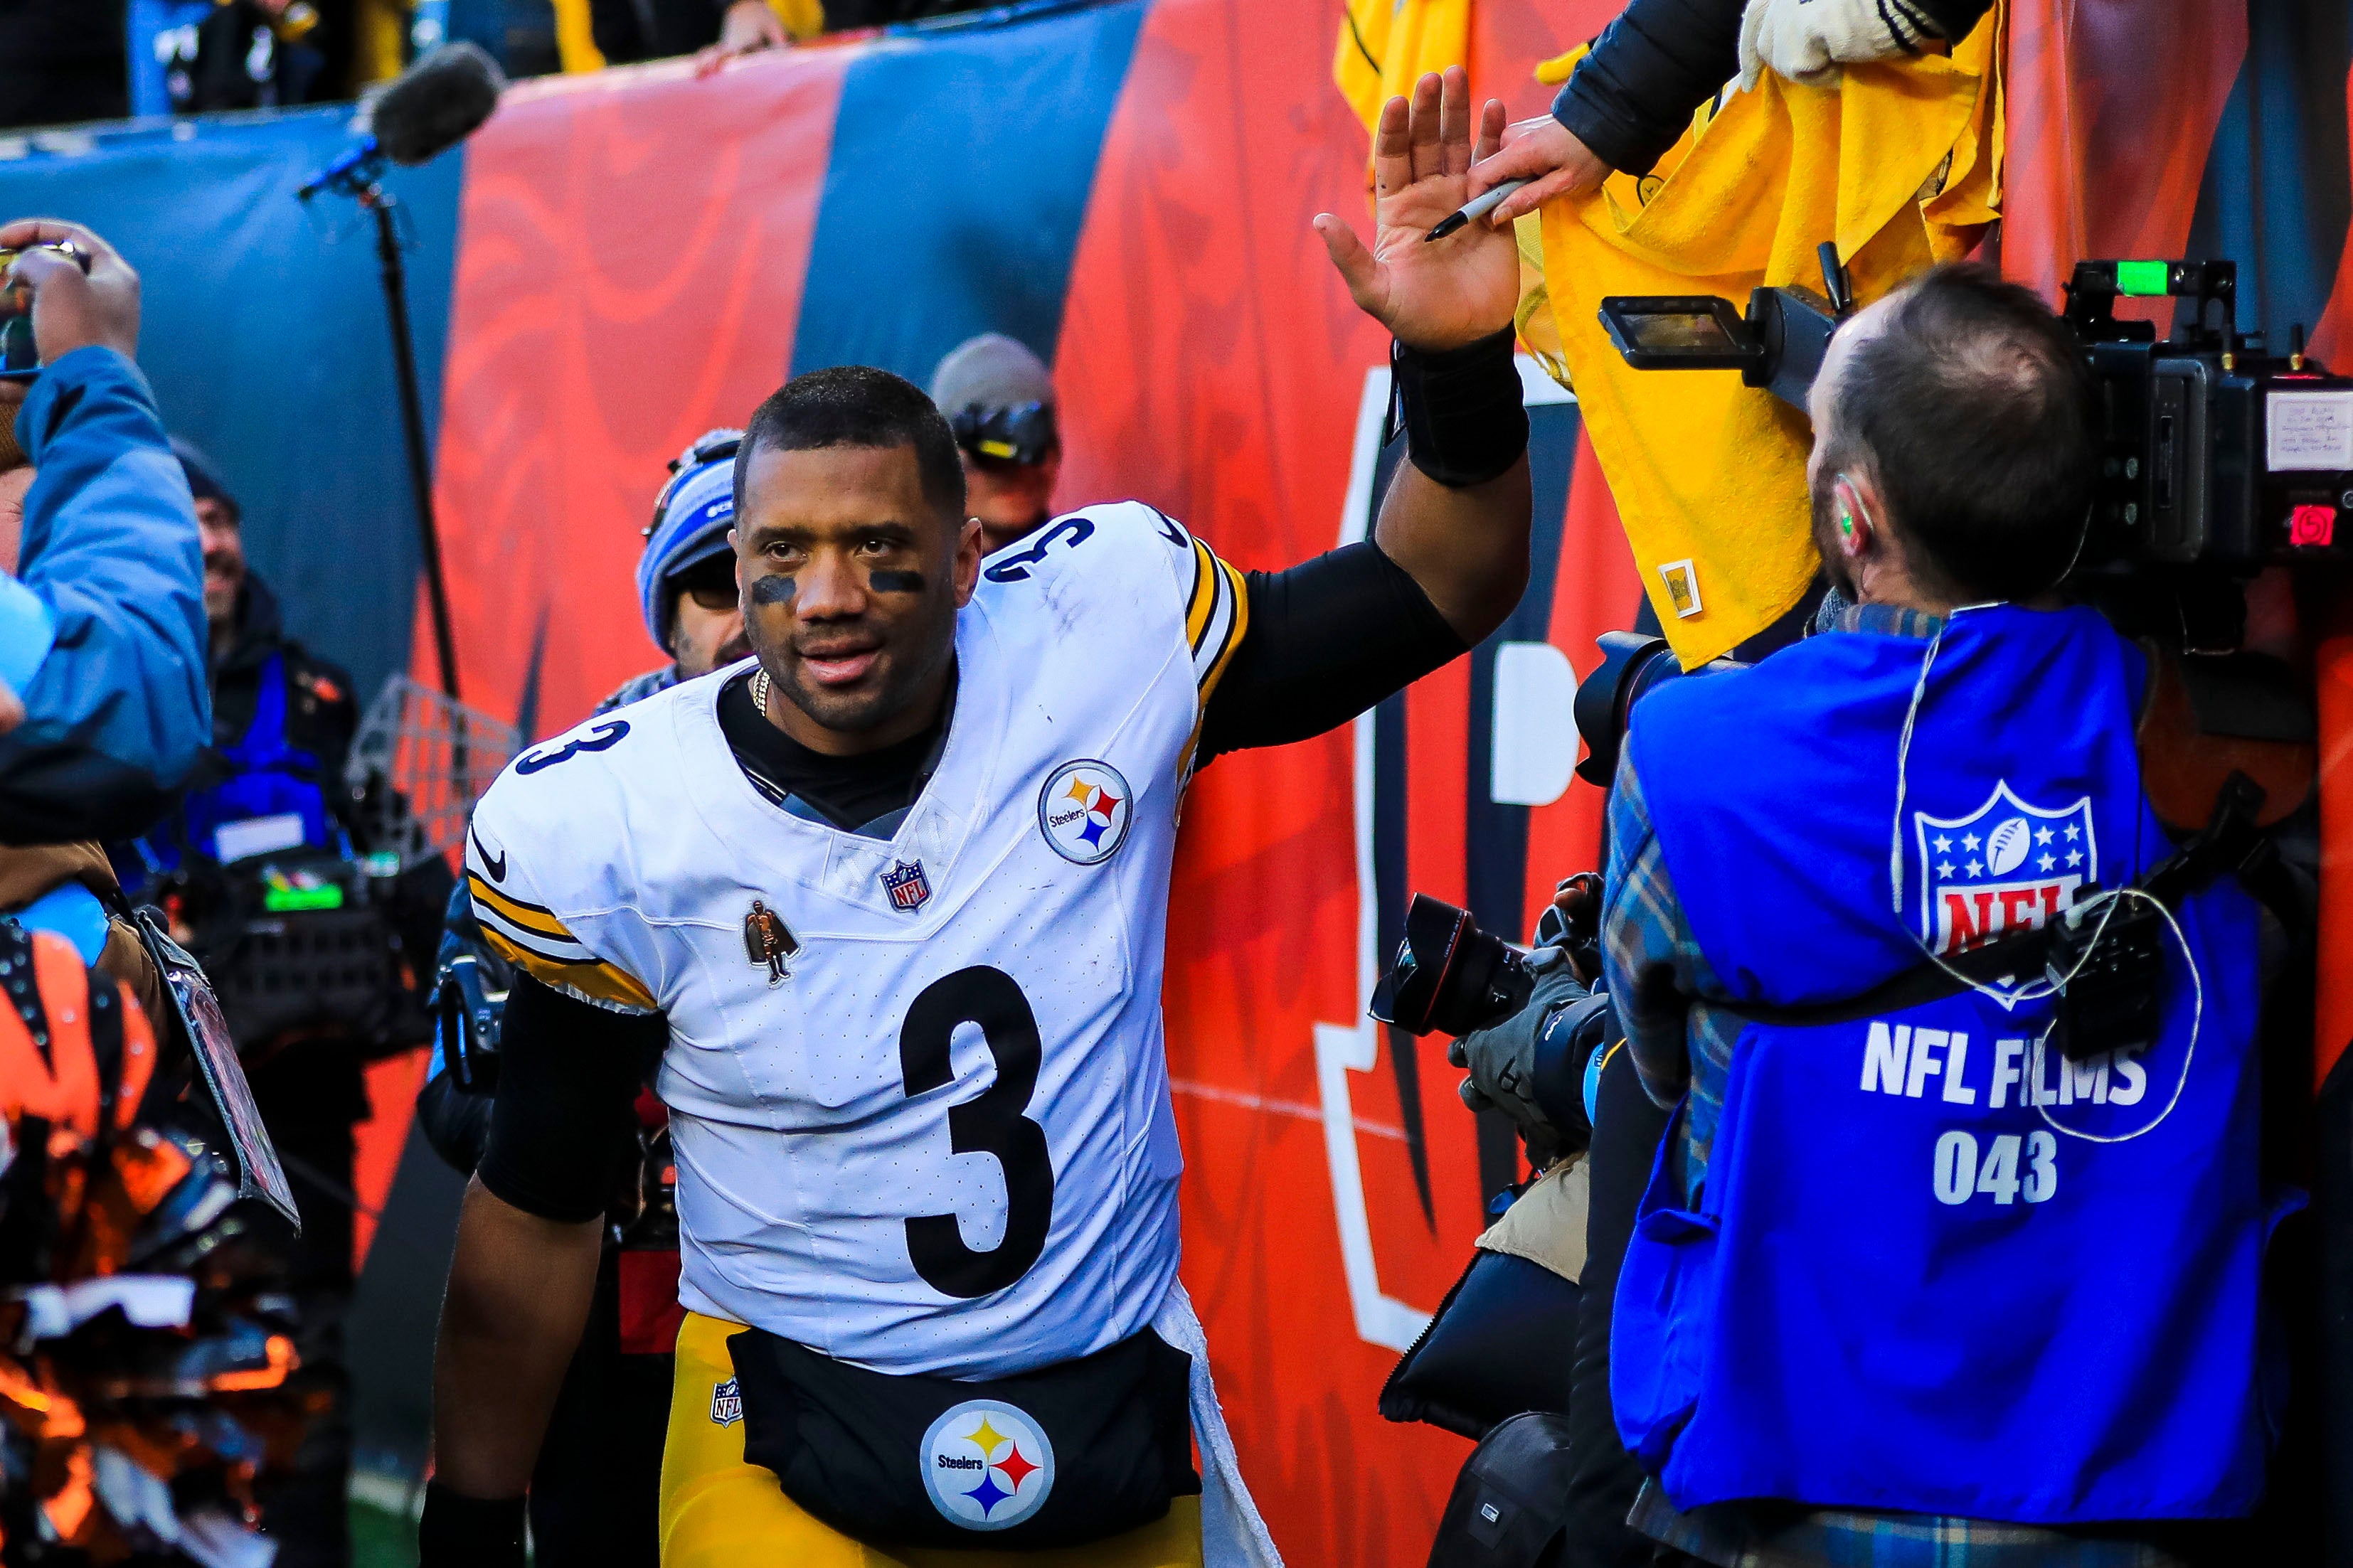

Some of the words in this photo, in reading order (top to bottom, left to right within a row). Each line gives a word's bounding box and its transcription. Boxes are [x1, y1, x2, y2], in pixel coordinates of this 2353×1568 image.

[983, 518, 1095, 582] 3
[516, 720, 630, 775] 3
[1049, 808, 1085, 828] Steelers
[893, 880, 926, 905] NFL
[1860, 1020, 1976, 1105] NFL
[899, 964, 1055, 1299] 3
[1933, 1129, 2058, 1205] 043
[715, 1398, 740, 1418] NFL
[938, 1454, 984, 1471] Steelers
